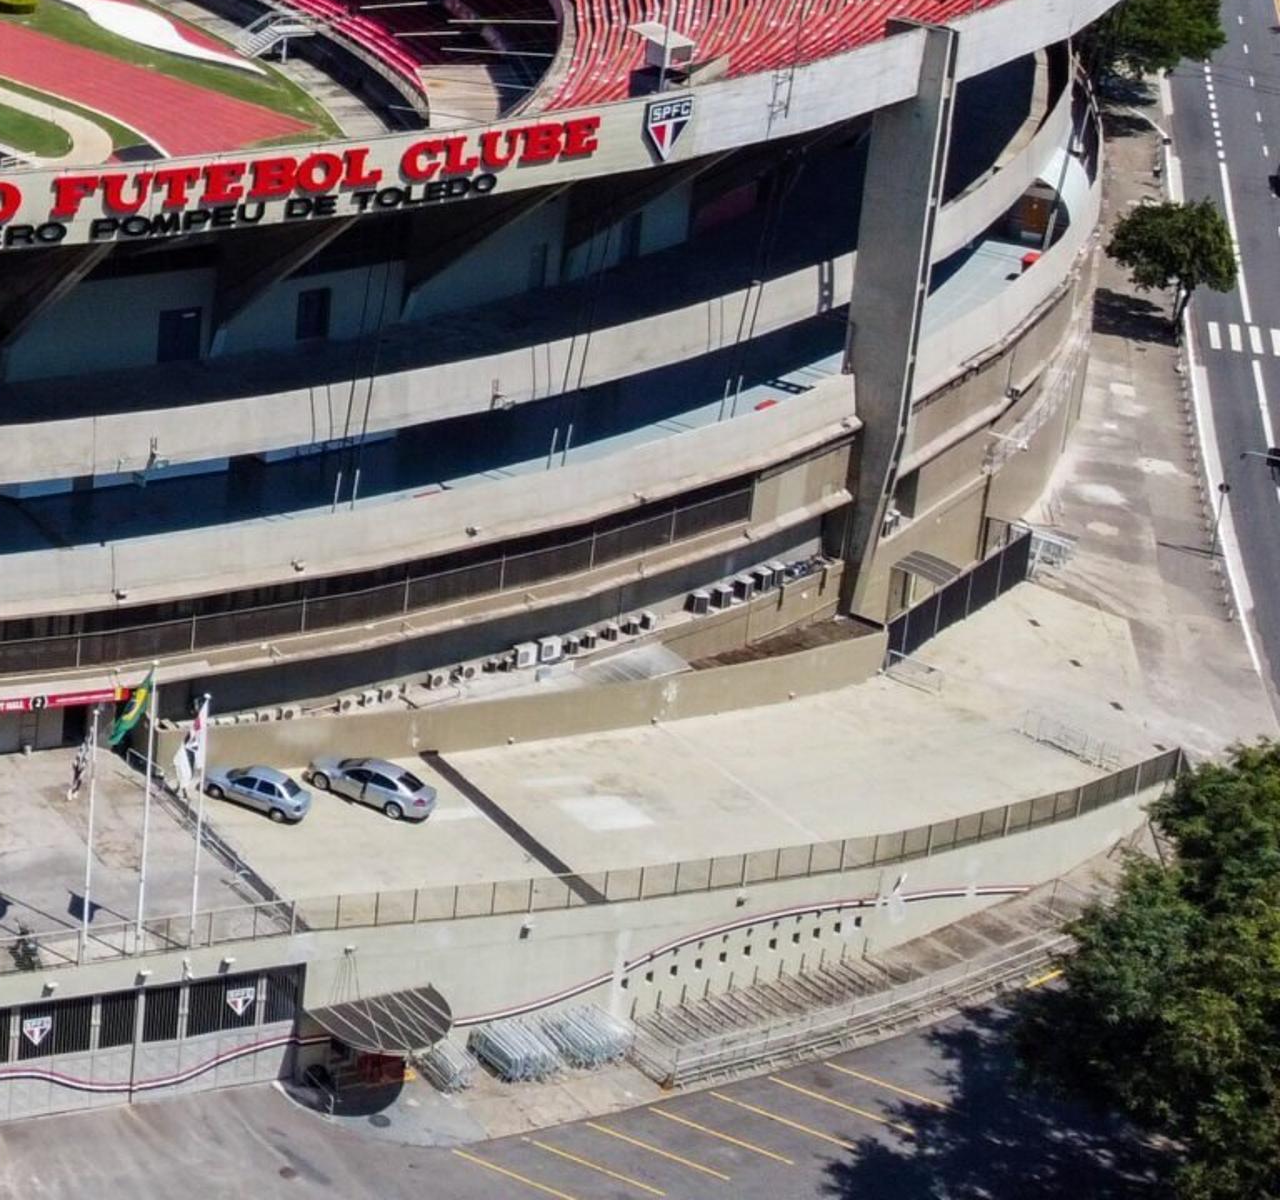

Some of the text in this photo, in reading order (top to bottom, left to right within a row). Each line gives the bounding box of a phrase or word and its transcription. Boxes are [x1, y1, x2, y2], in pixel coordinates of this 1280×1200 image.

[651, 100, 692, 123] SPFC
[52, 147, 383, 216] FUTEBOL
[401, 116, 601, 183] CLUBE
[91, 203, 265, 241] POMPEU
[284, 193, 337, 218] DE
[357, 172, 498, 210] TOLEDO
